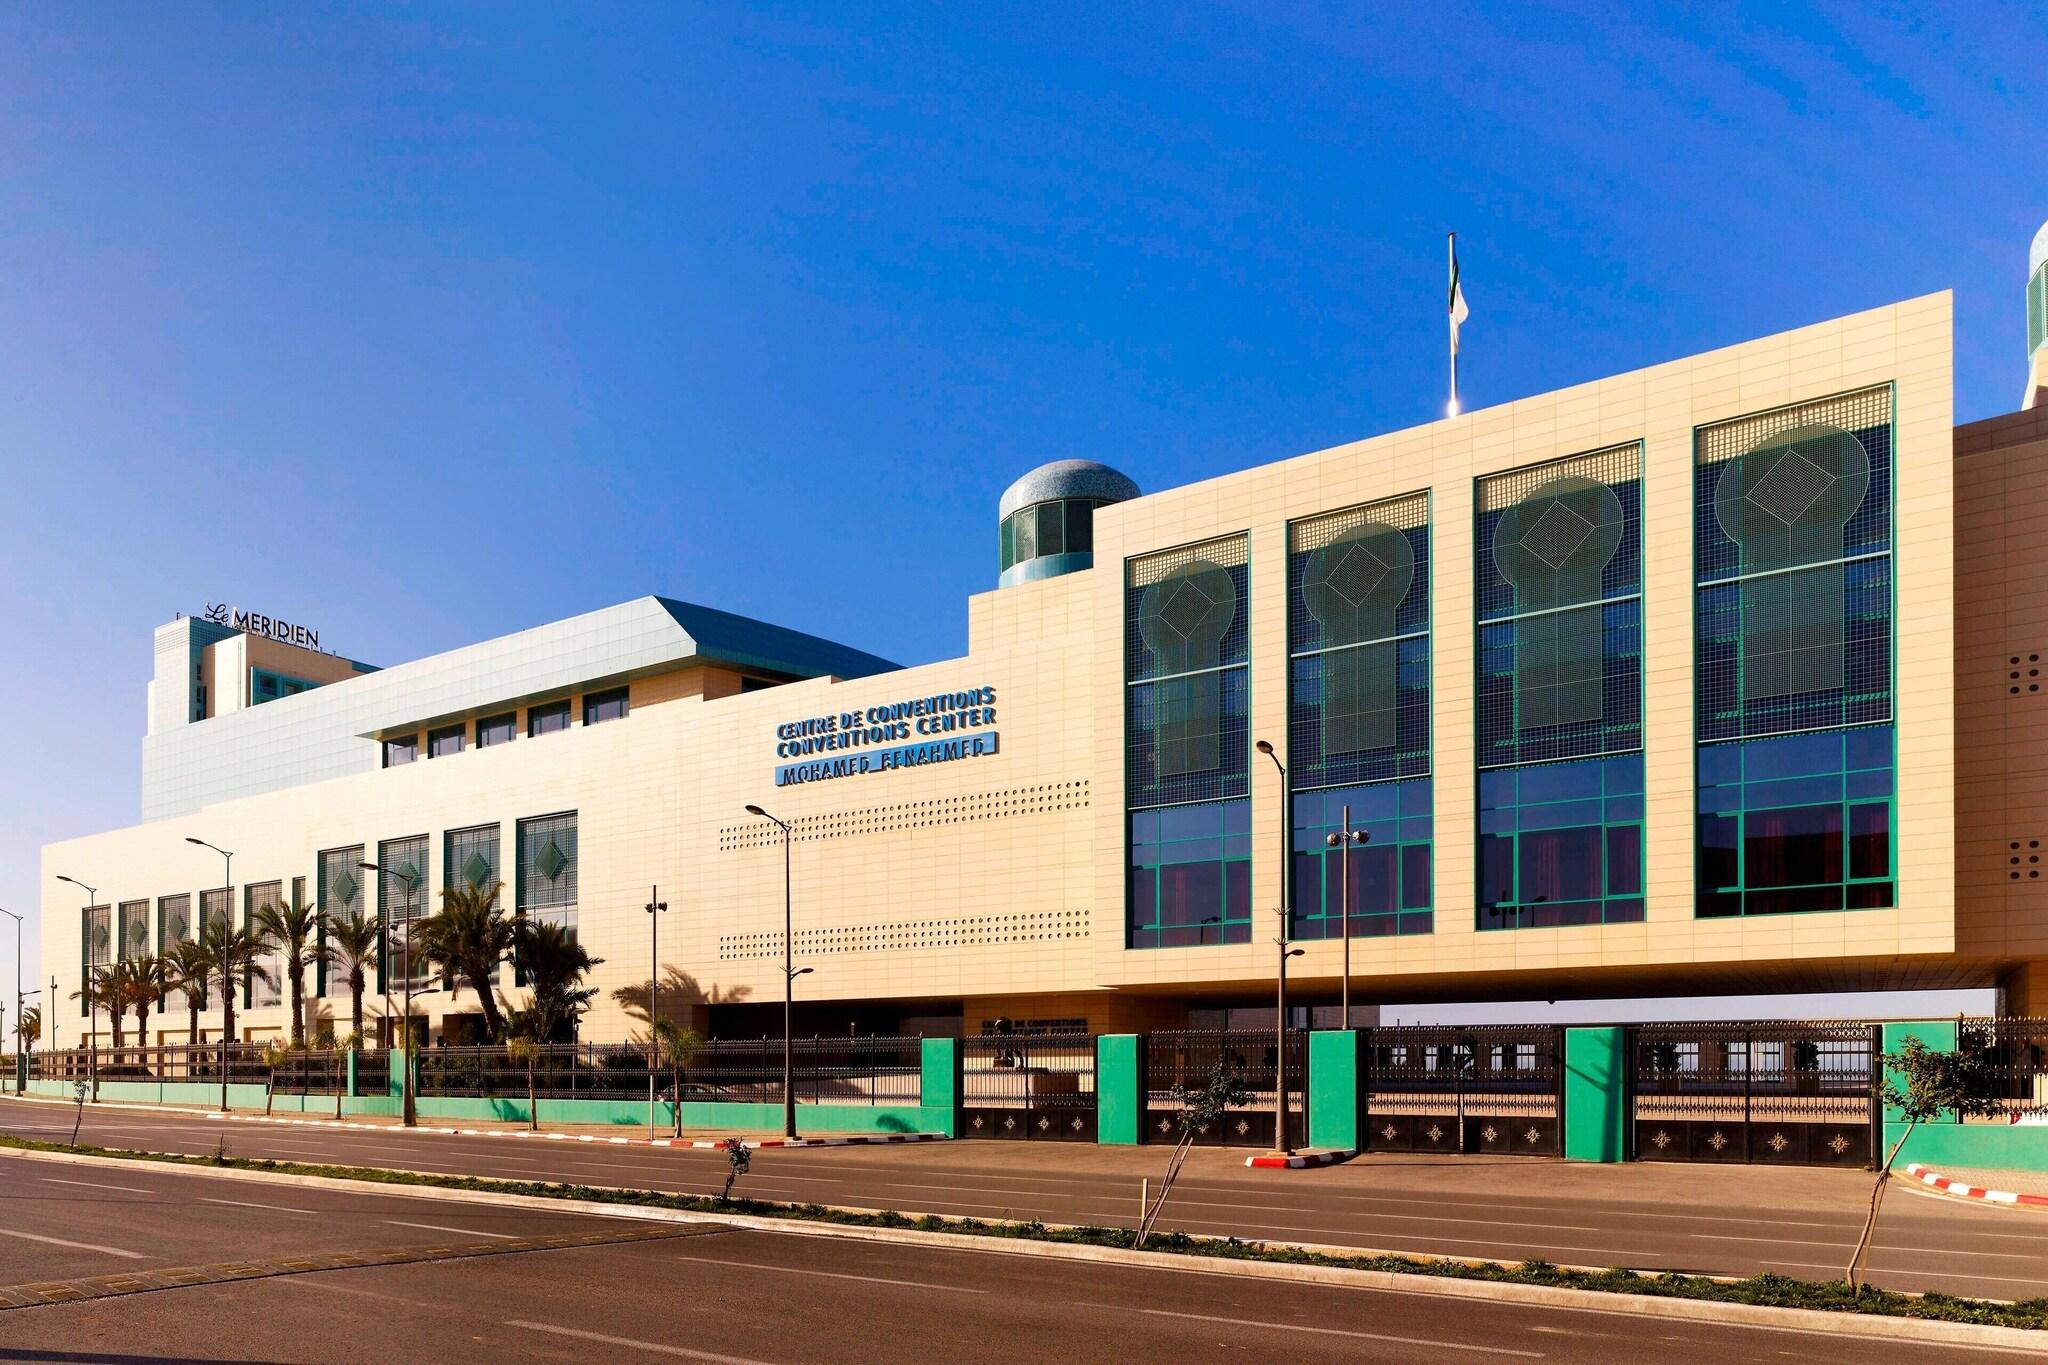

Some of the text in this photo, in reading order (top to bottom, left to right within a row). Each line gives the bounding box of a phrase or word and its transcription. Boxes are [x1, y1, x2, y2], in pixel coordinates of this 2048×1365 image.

[205, 602, 229, 622] Le
[777, 686, 997, 740] CENTRE DE CONVENTIONS
[777, 707, 997, 758] CONVENTIONS CENTER
[782, 757, 870, 786] MOHAMED
